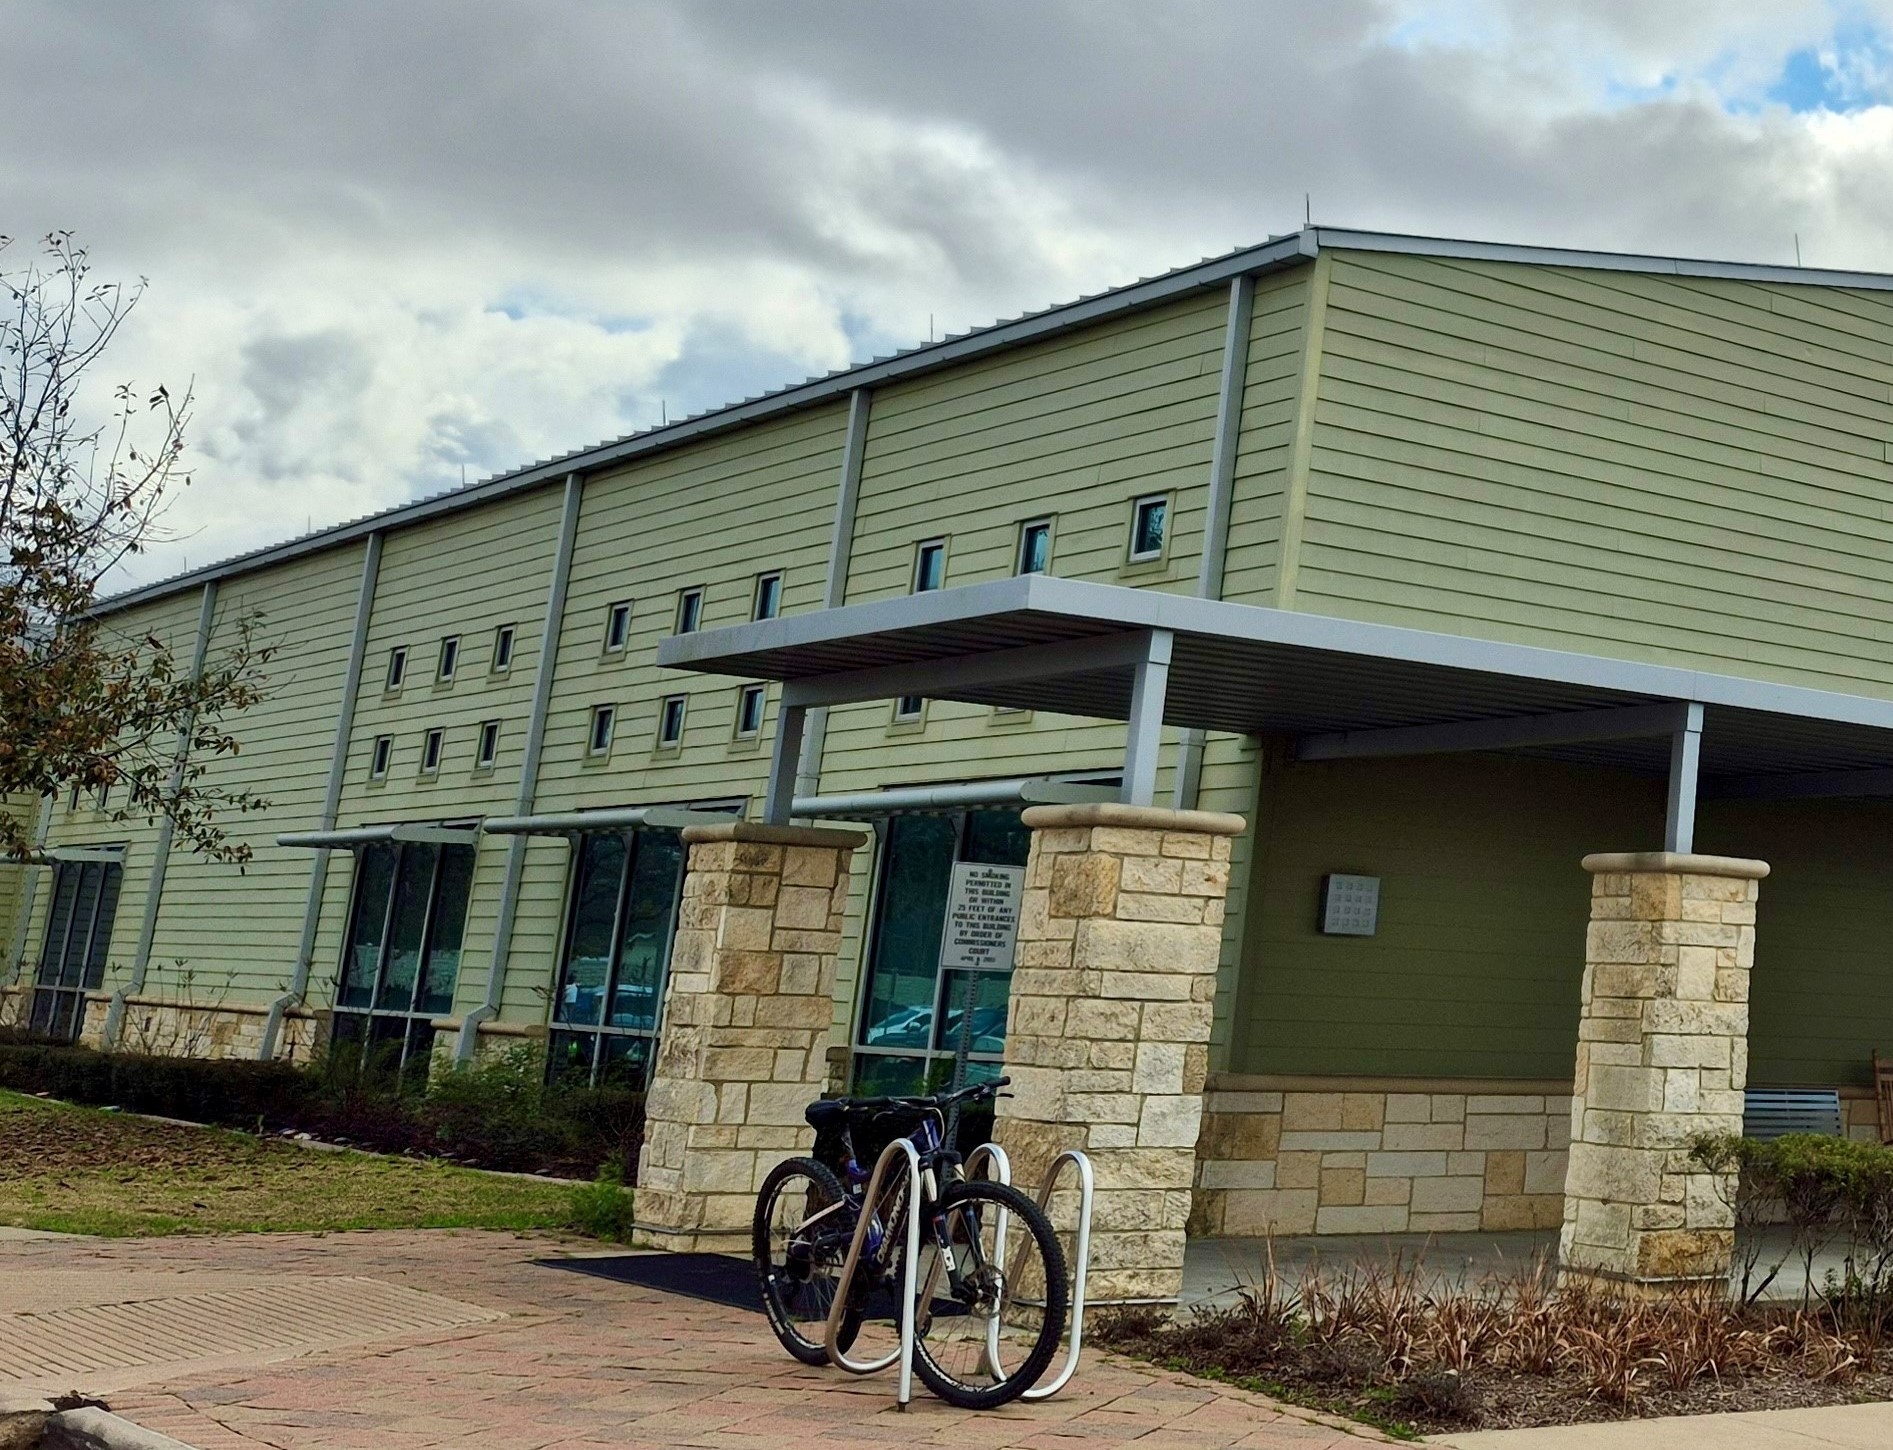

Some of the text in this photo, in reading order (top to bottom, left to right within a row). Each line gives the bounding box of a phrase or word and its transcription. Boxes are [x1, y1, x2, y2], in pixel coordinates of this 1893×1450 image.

[982, 872, 1010, 880] SMOKING
[978, 914, 1015, 923] ENTRANCES
[954, 938, 1006, 948] COMMISSIONERS
